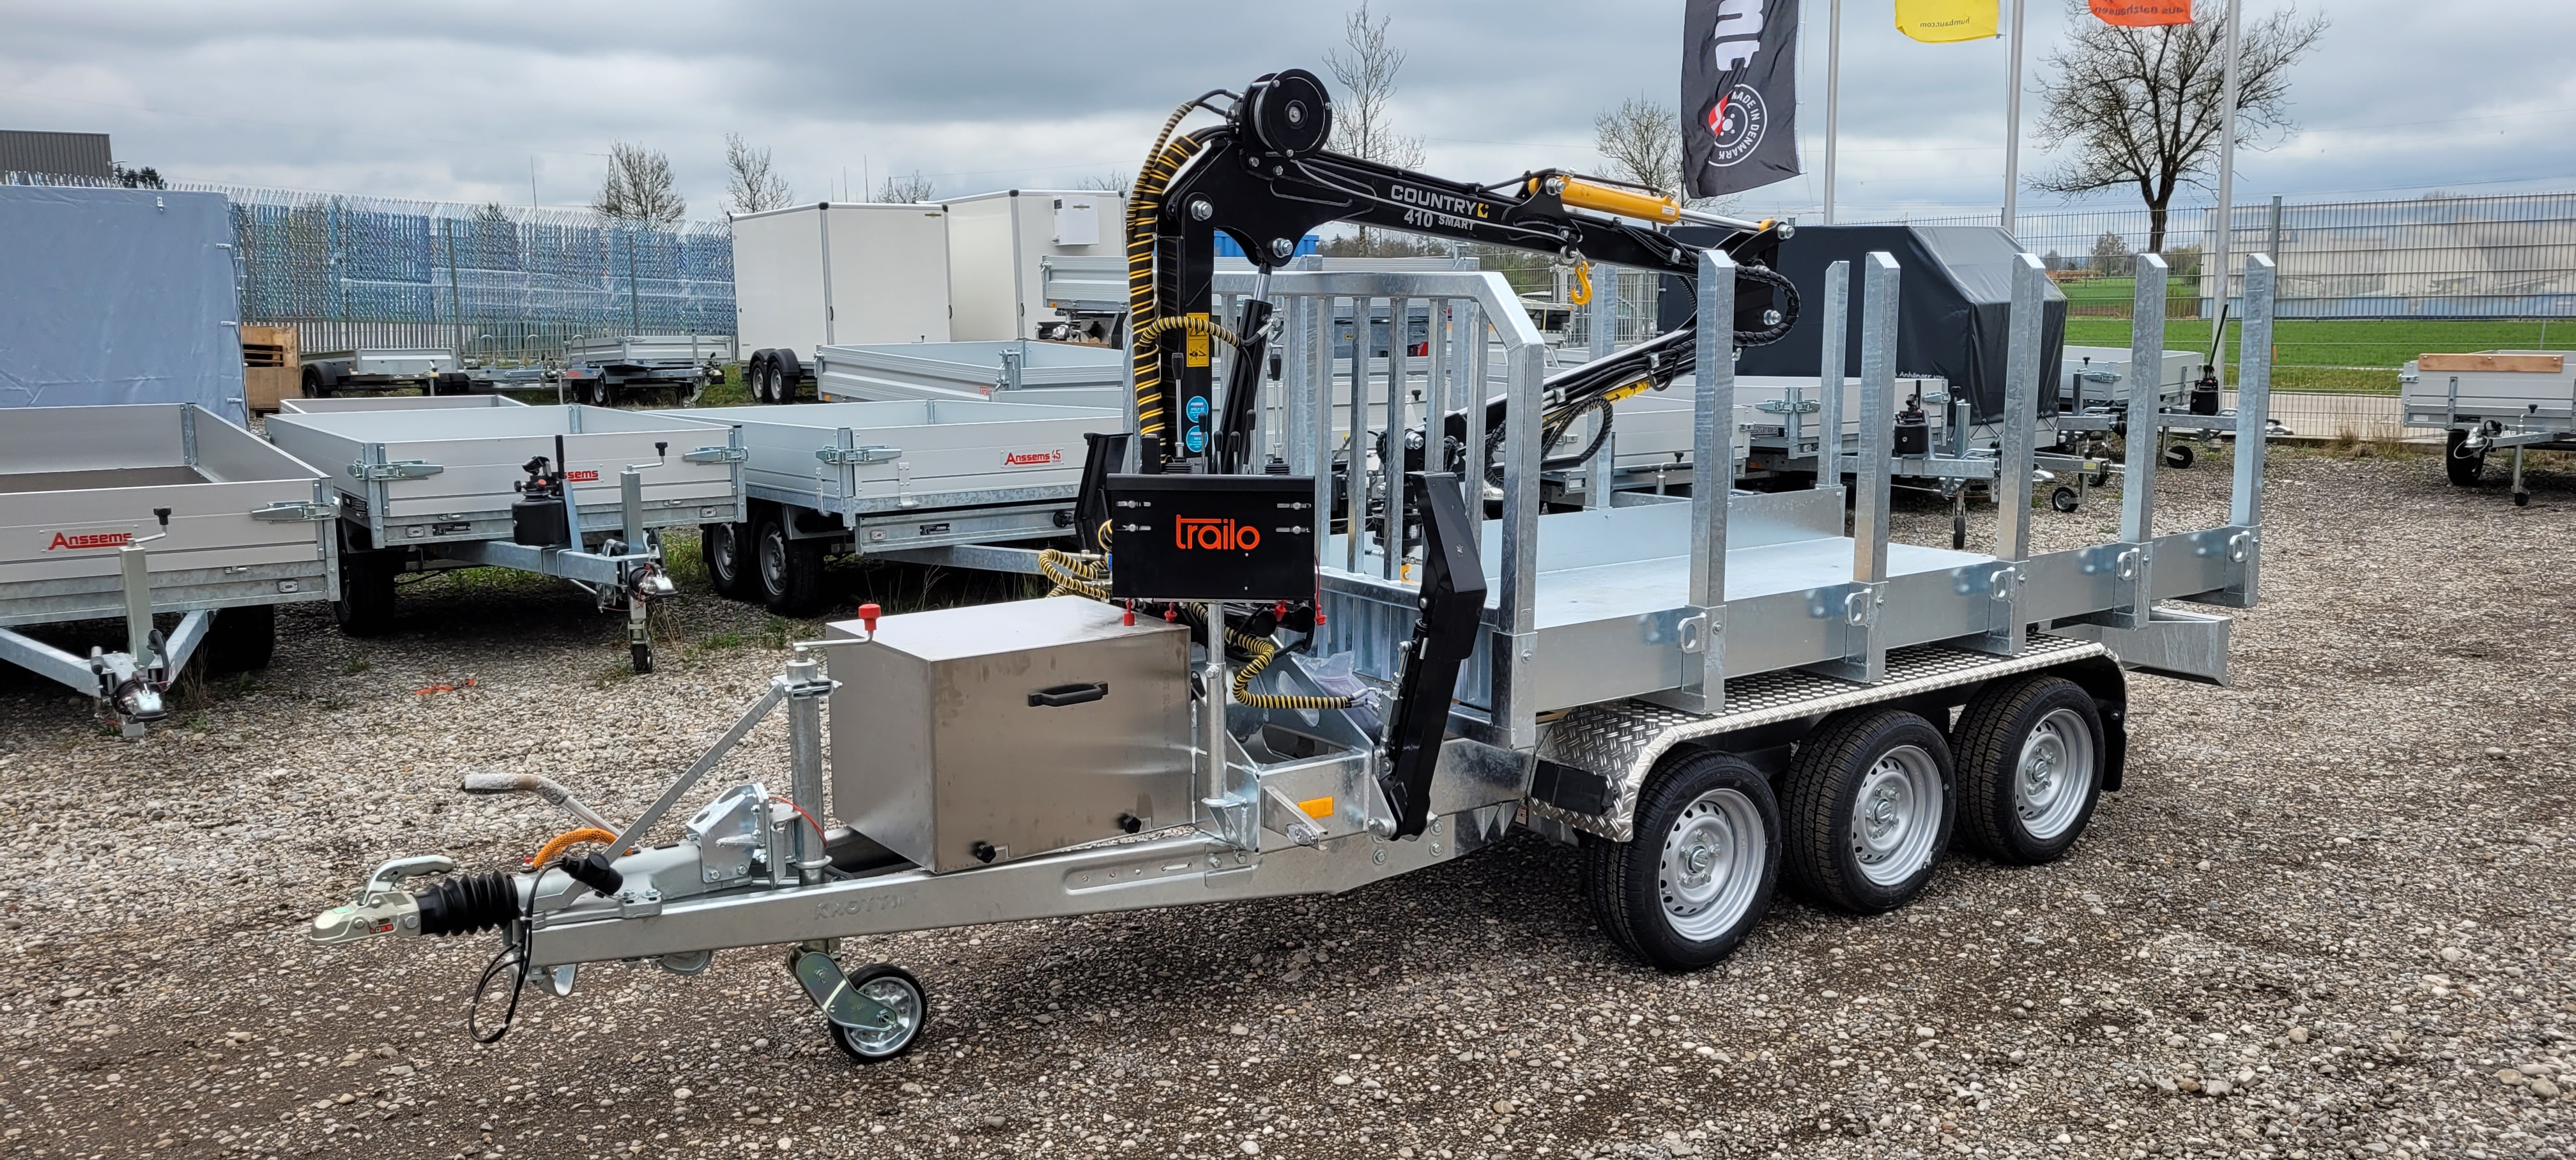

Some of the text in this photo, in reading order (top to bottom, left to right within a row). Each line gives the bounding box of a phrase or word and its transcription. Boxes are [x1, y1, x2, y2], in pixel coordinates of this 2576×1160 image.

[1750, 109, 1760, 121] IN
[1719, 124, 1760, 160] DENMARK
[1391, 185, 1477, 215] COUNTRY
[1404, 210, 1475, 231] 410 SMART
[1004, 452, 1050, 466] Anssems
[564, 470, 599, 482] sems
[48, 532, 132, 550] Anssems
[1176, 514, 1260, 550] trailo
